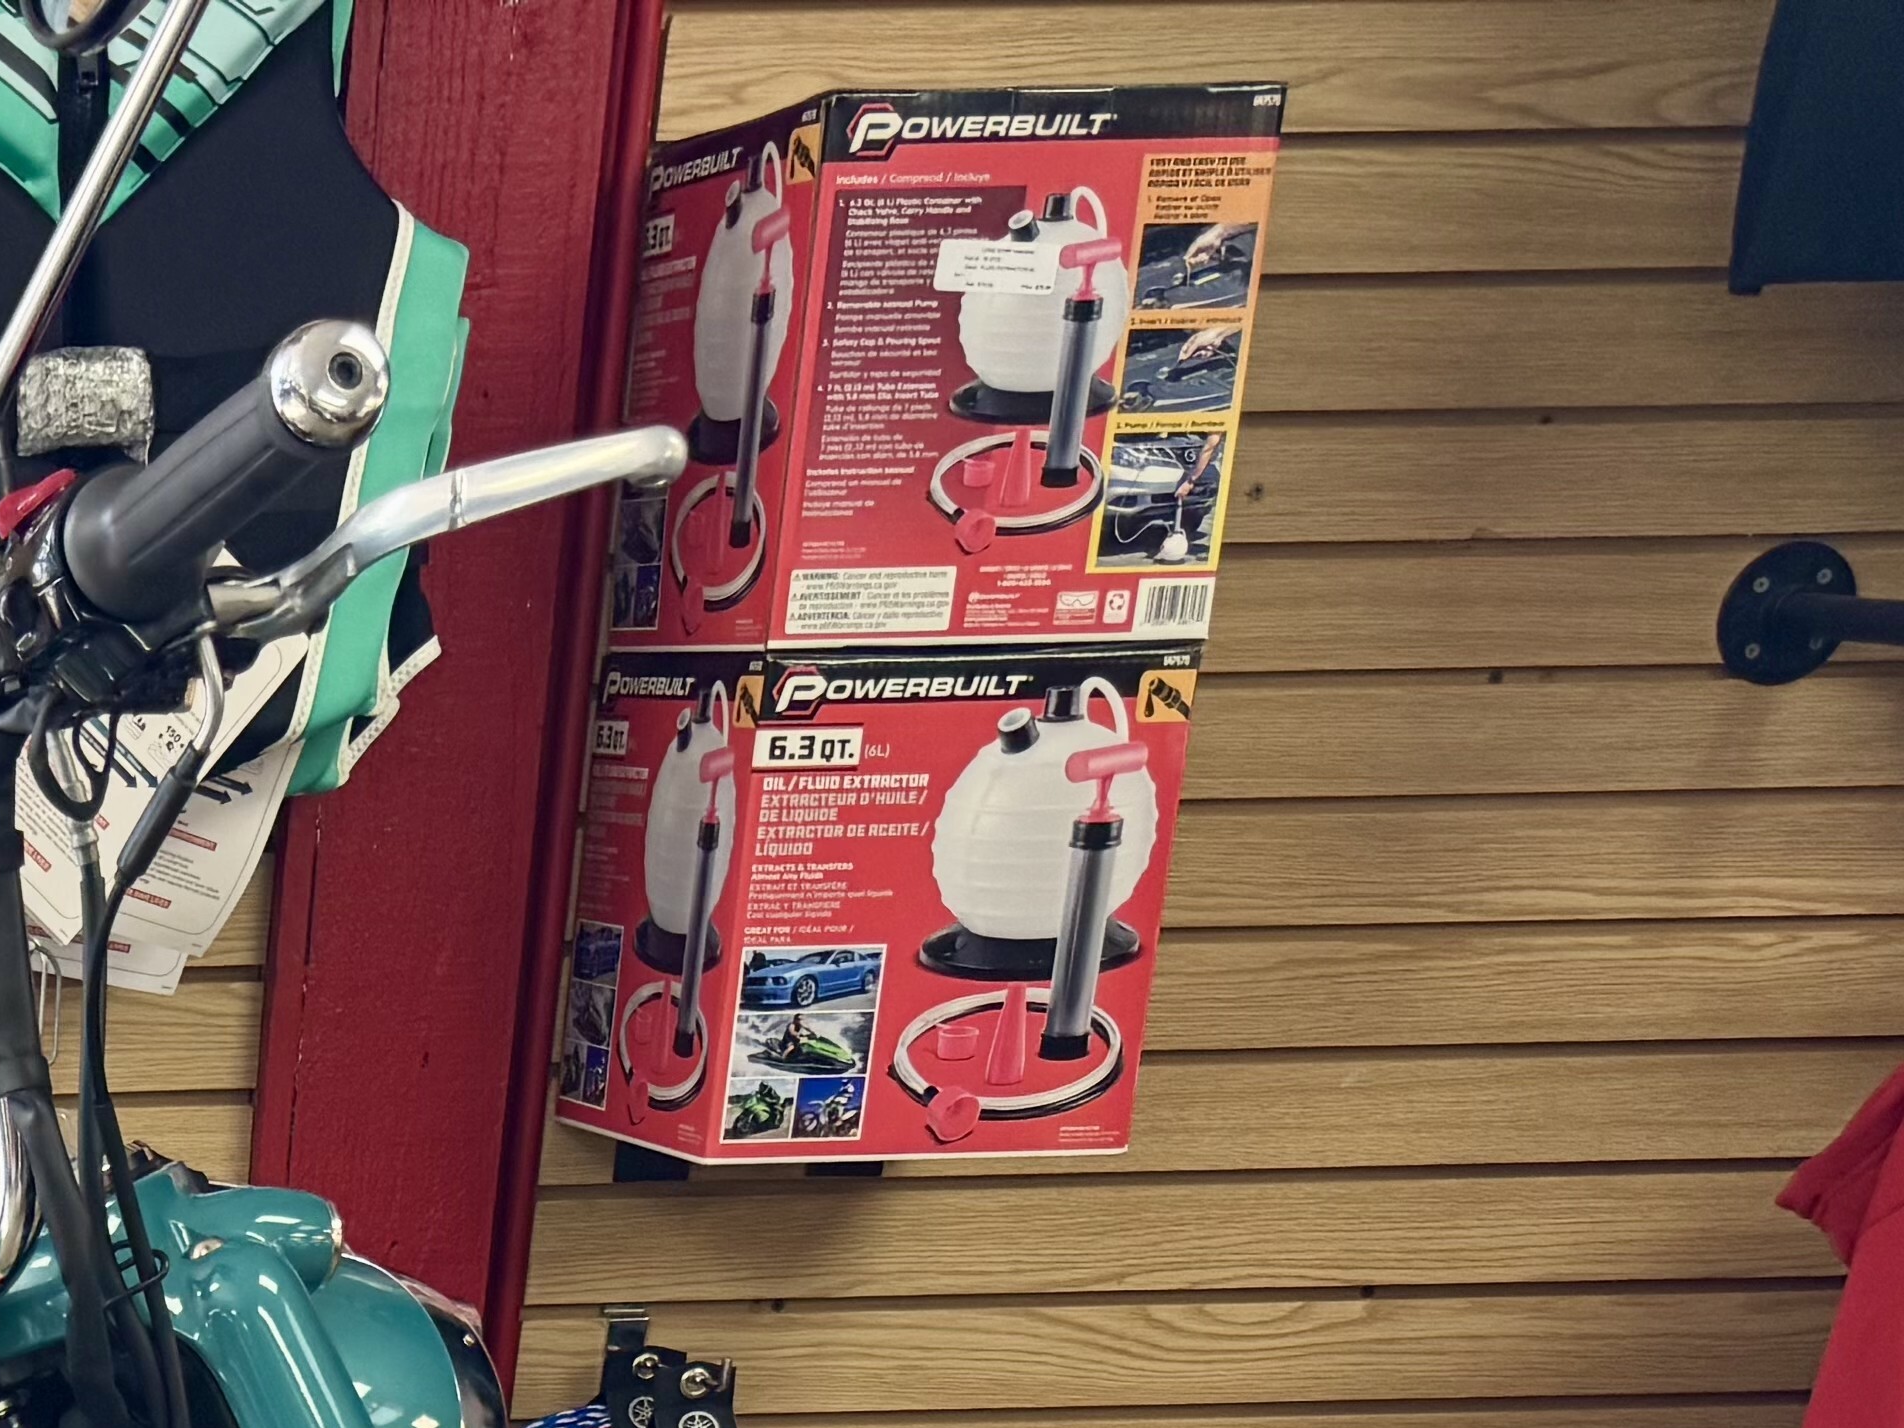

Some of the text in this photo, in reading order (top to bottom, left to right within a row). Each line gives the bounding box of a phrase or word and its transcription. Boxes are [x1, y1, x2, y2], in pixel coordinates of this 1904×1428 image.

[848, 112, 1110, 154] POWERBUILT
[651, 148, 743, 191] POWERBUILT
[602, 672, 695, 704] POWERBUILT
[775, 676, 1028, 713] POWERBUILT
[768, 736, 889, 763] 6.3 QT. (6L)
[843, 774, 929, 789] EXTRACTOR
[761, 793, 856, 807] EXTRACTEUR
[759, 808, 838, 823] DE LIQUIDE
[757, 825, 866, 839] EXTRACTOR DE
